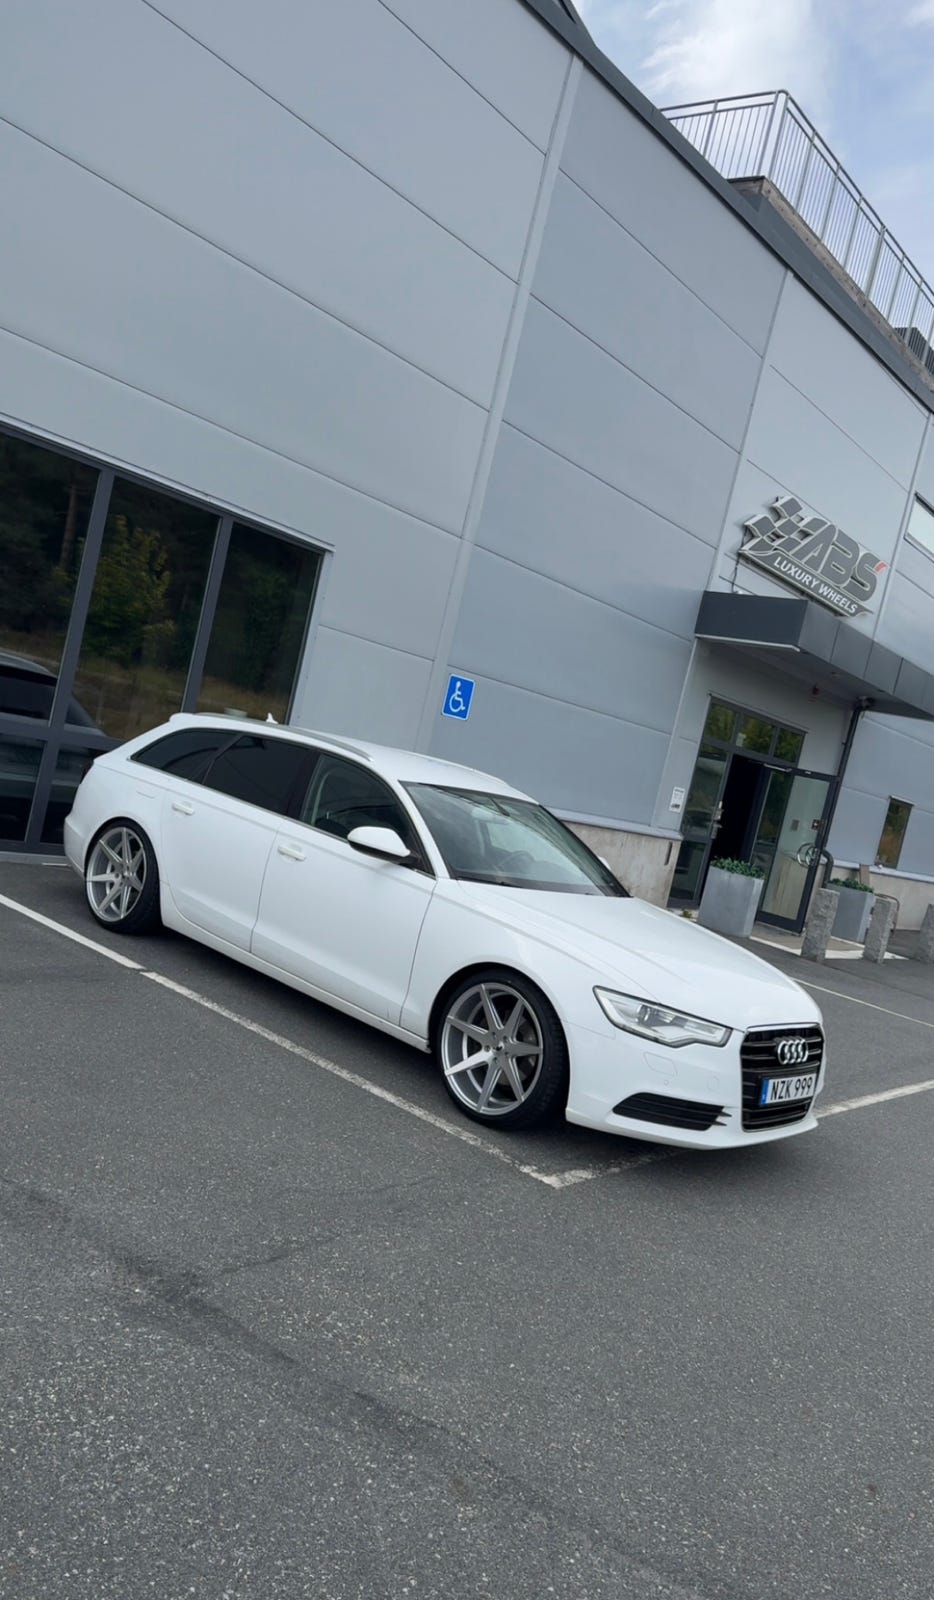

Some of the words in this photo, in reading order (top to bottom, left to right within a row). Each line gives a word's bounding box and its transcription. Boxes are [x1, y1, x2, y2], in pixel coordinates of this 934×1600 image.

[773, 556, 819, 590] LUXURY
[817, 584, 858, 614] WHEELS
[790, 523, 889, 602] ABS
[770, 1079, 793, 1101] NZK
[793, 1076, 813, 1097] 999
